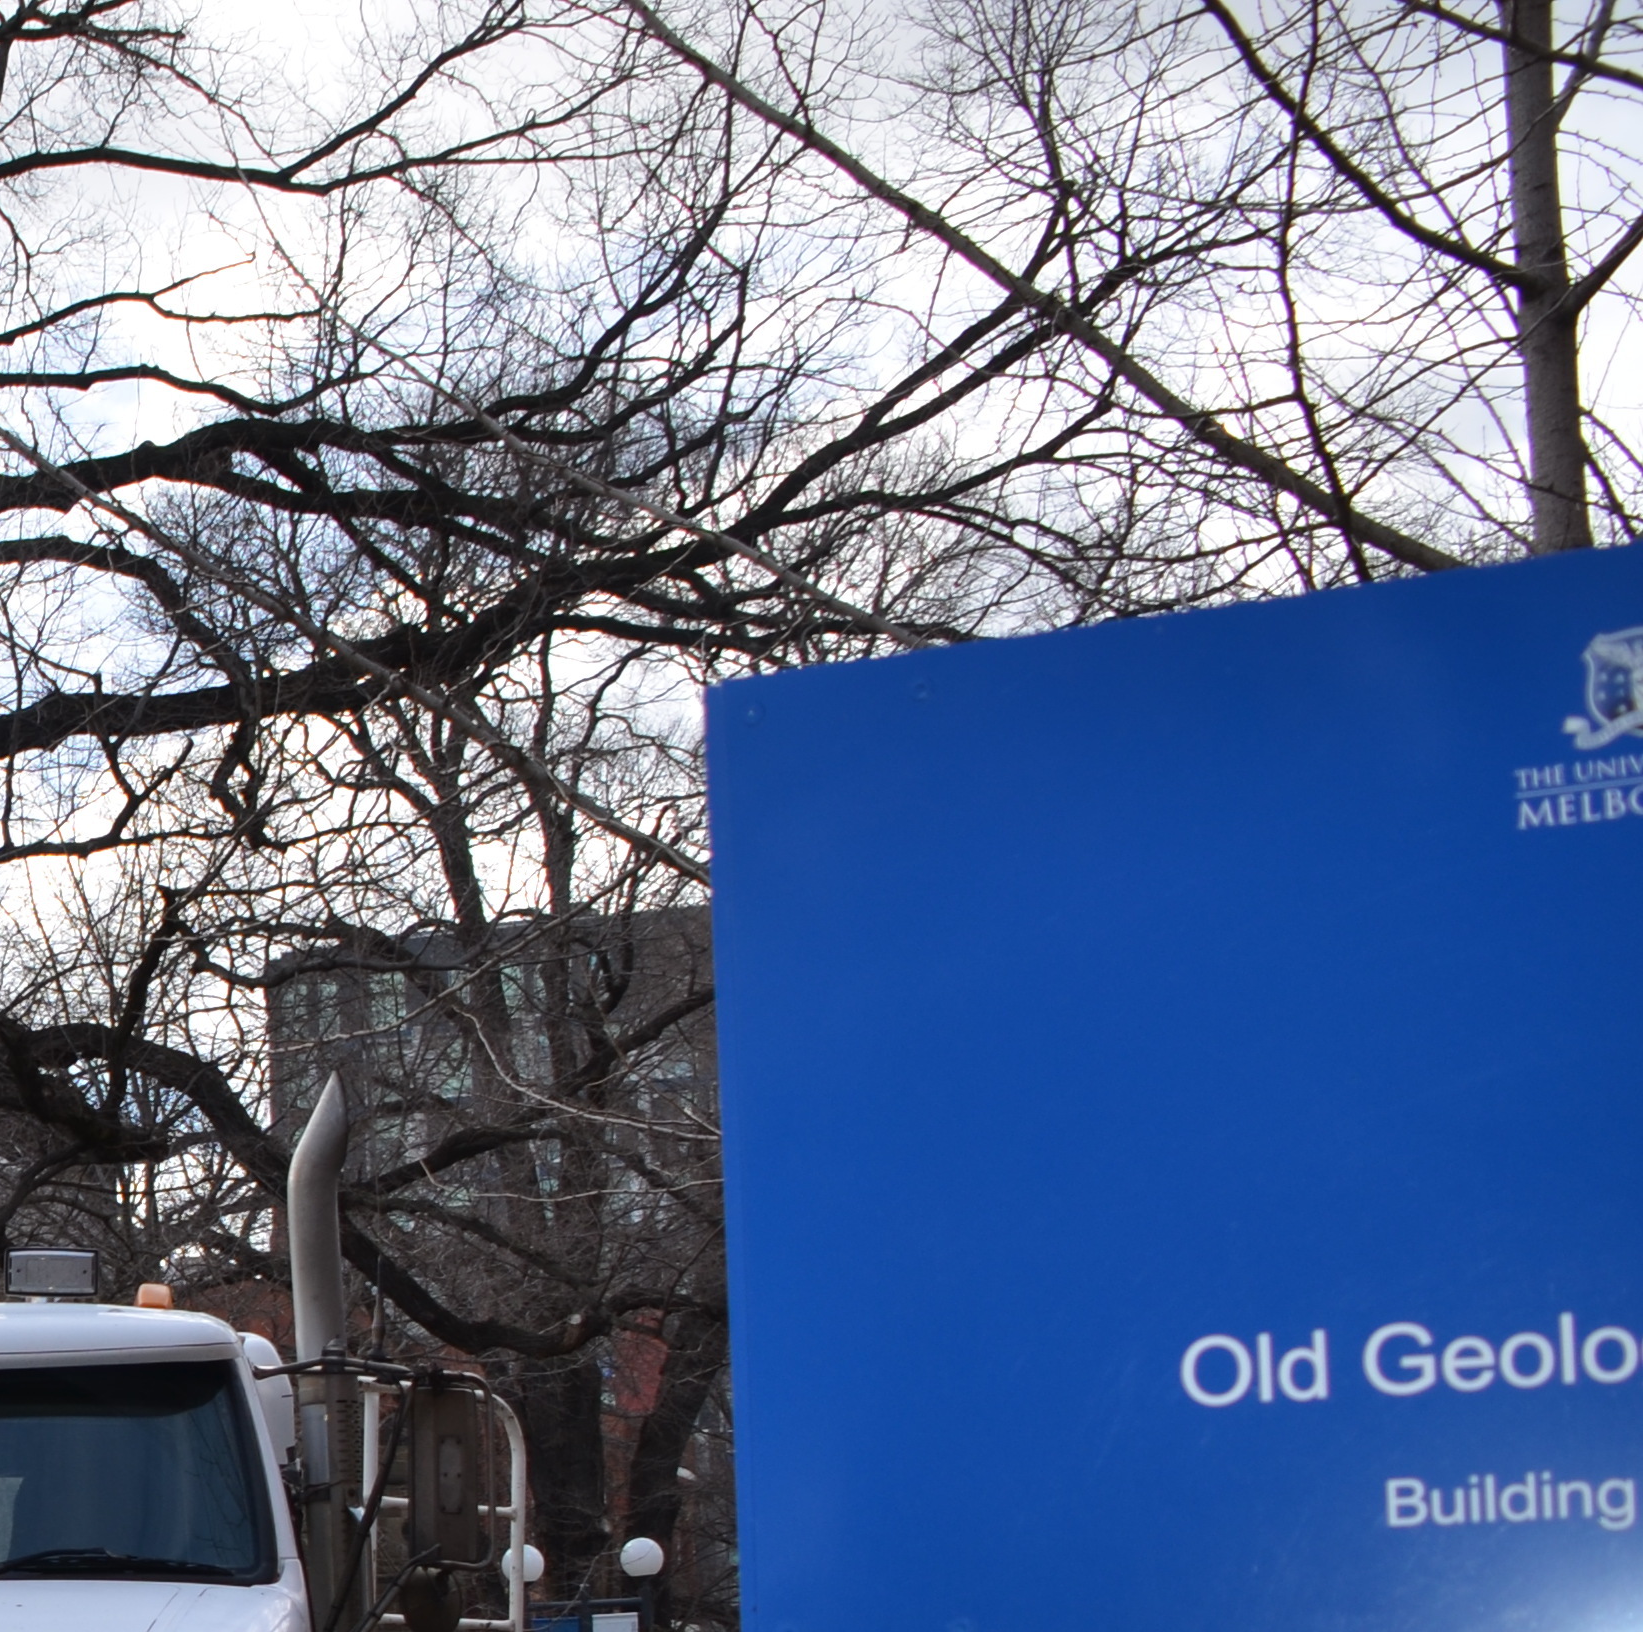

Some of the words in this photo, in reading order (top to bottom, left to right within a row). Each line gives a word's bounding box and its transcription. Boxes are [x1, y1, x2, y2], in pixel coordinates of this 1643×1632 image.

[1516, 763, 1564, 789] THE
[1181, 1329, 1329, 1407] Old
[1363, 1312, 1643, 1396] Geolo
[1387, 1472, 1636, 1531] Building
